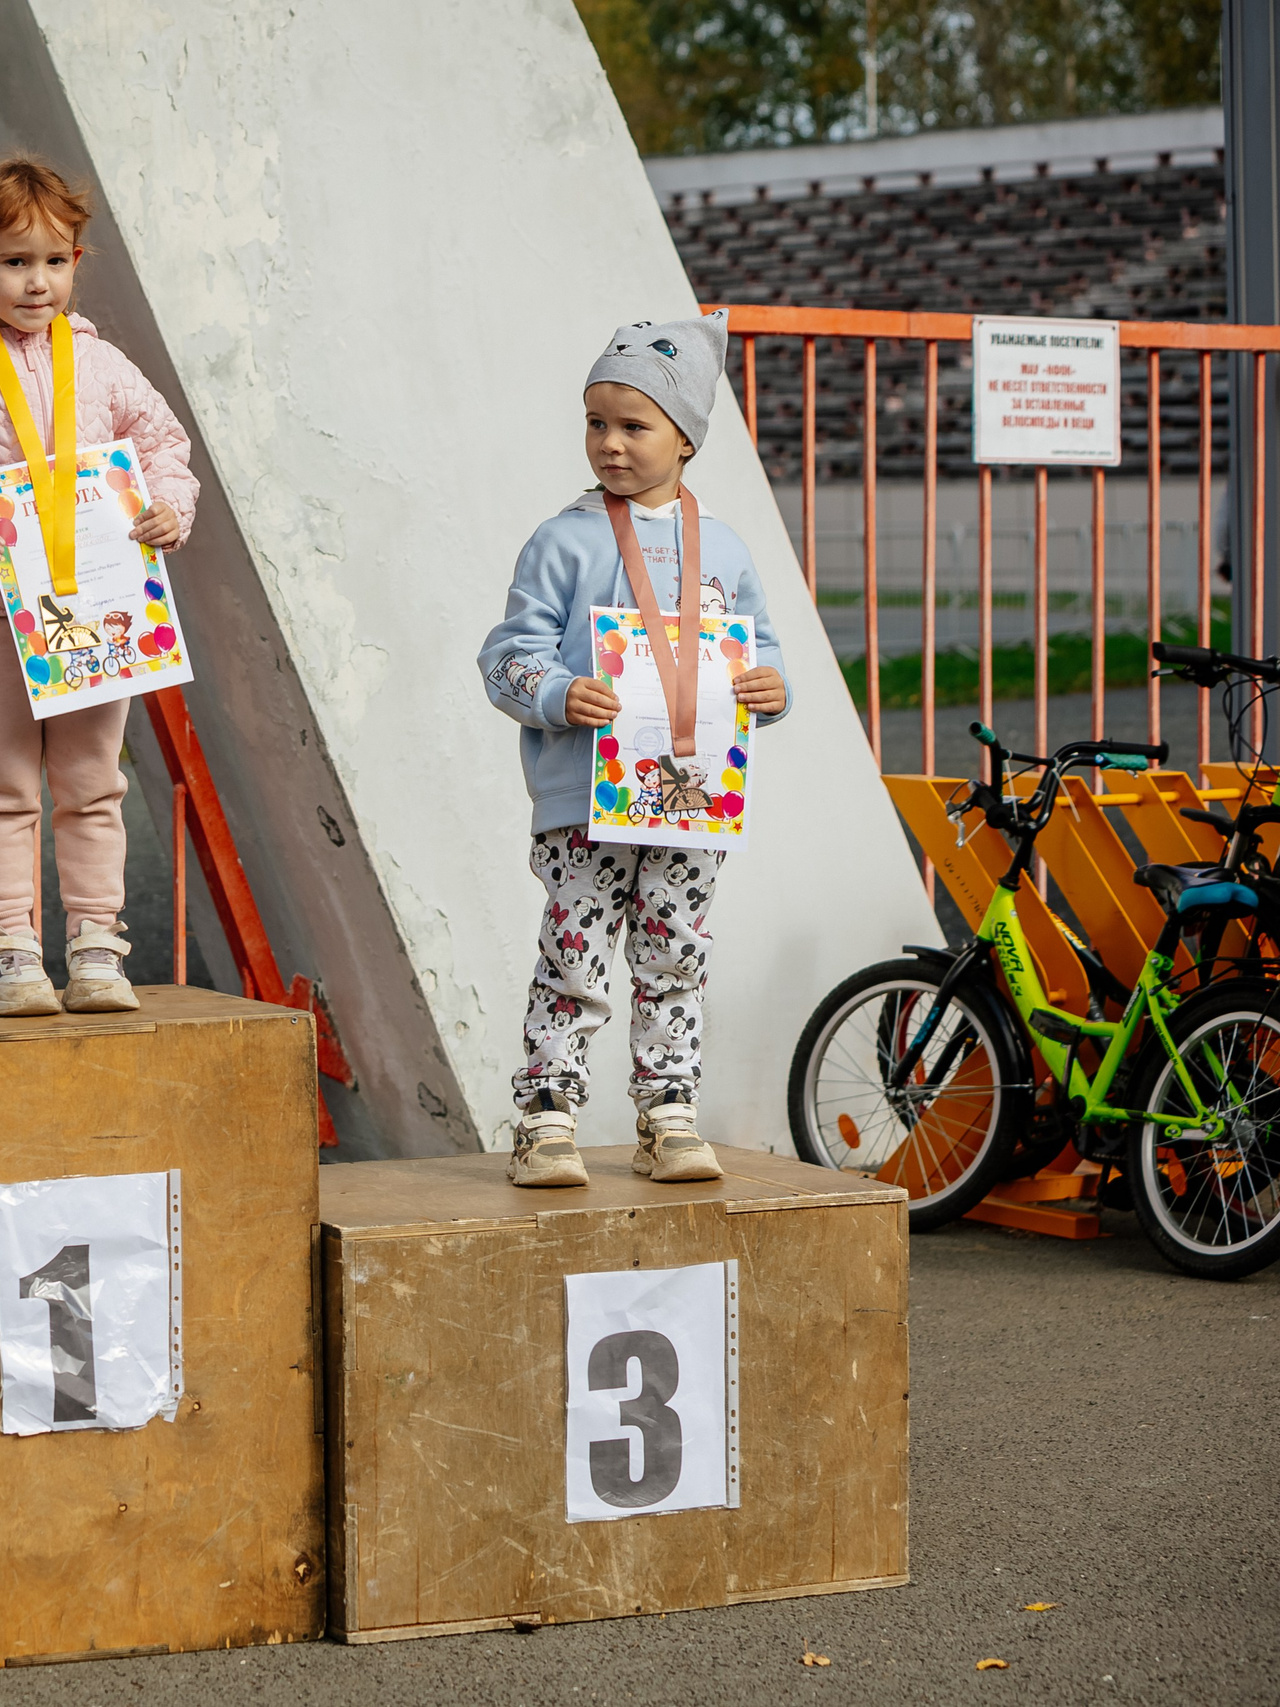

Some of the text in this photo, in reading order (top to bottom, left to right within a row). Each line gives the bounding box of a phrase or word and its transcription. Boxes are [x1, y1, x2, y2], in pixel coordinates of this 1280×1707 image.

[990, 333, 1046, 347] УВАЖАЕМЫЕ
[1031, 382, 1107, 395] ОТВЕТСТВЕННОСТИ
[1025, 399, 1085, 411] ОСТАВЛЕННЫЕ
[1002, 415, 1059, 429] ВЕЛОСИПЕДЫ
[19, 1244, 97, 1423] 1
[587, 1329, 683, 1508] 3
